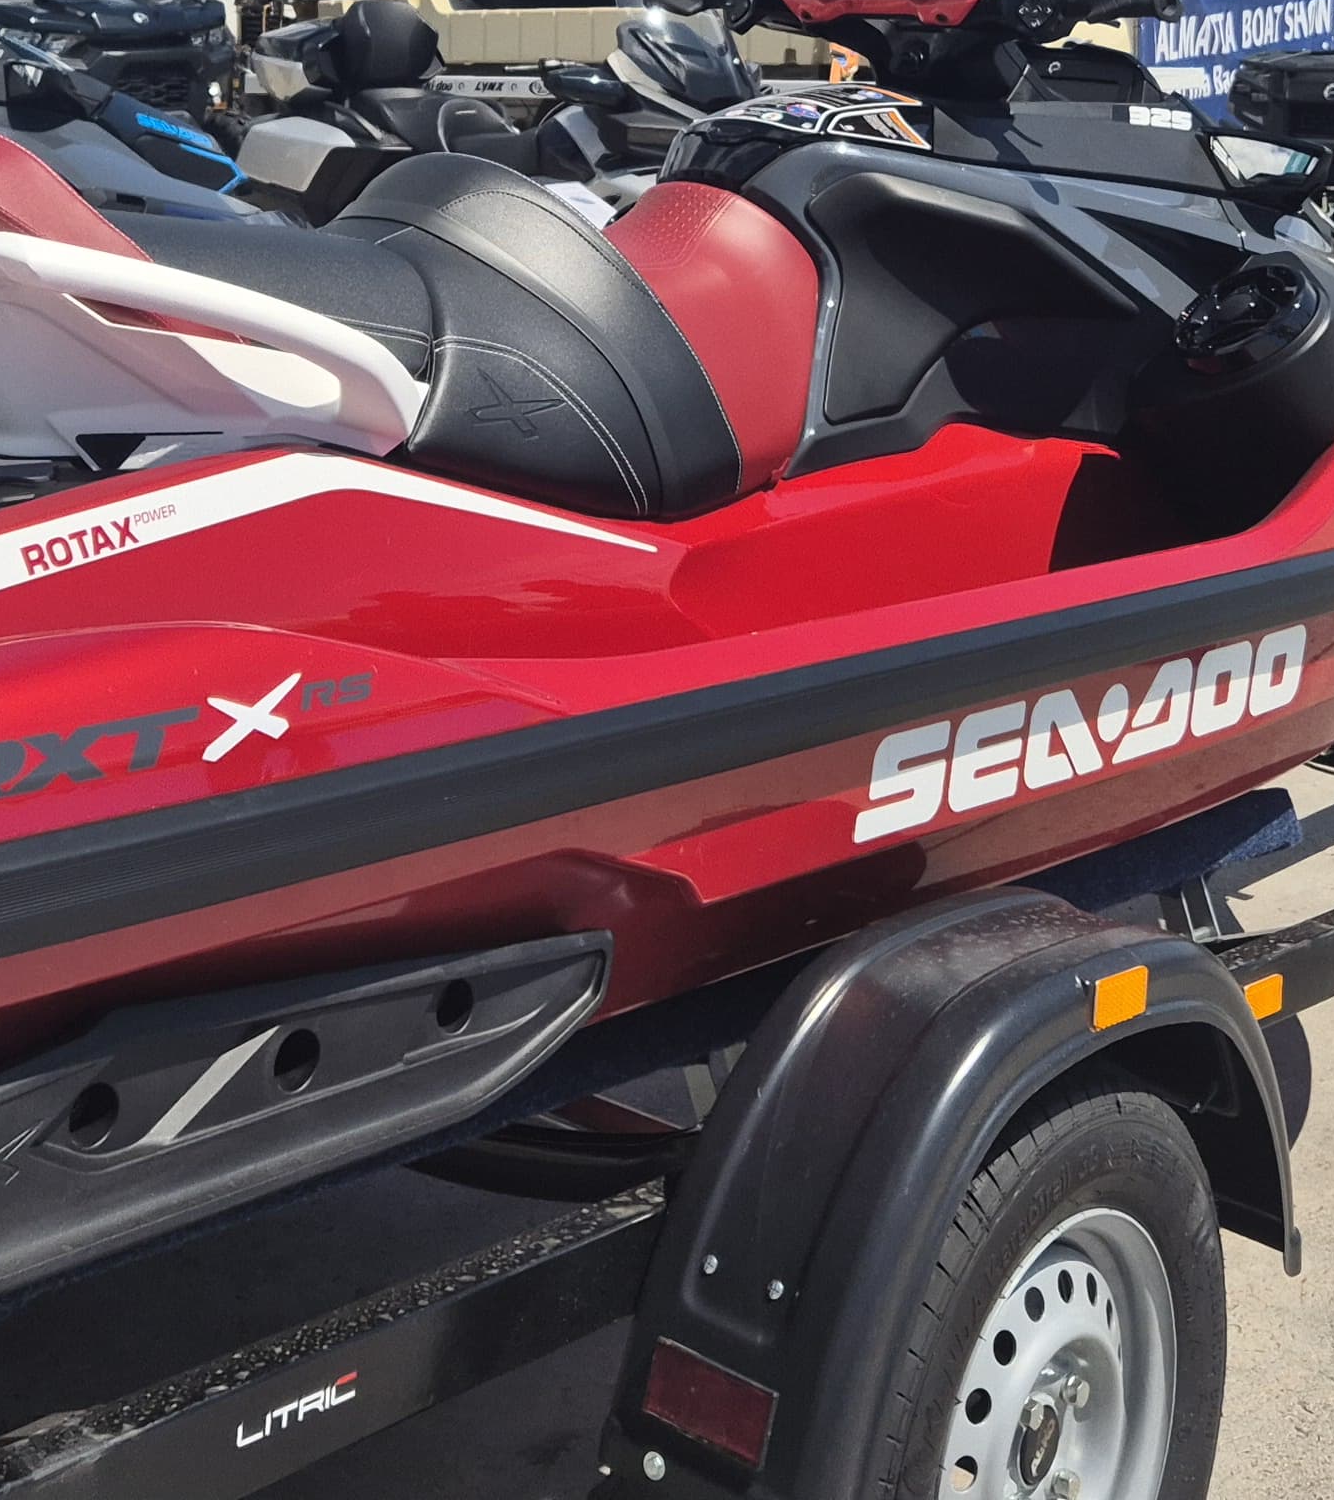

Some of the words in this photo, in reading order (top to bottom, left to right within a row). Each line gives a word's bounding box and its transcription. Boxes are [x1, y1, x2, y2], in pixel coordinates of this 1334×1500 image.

[1241, 3, 1284, 49] BOAT
[1128, 105, 1193, 131] 325
[19, 516, 140, 577] ROTAX
[133, 503, 178, 528] POWER
[202, 672, 303, 763] X
[300, 672, 375, 713] RS
[236, 1370, 360, 1448] LITRIC
